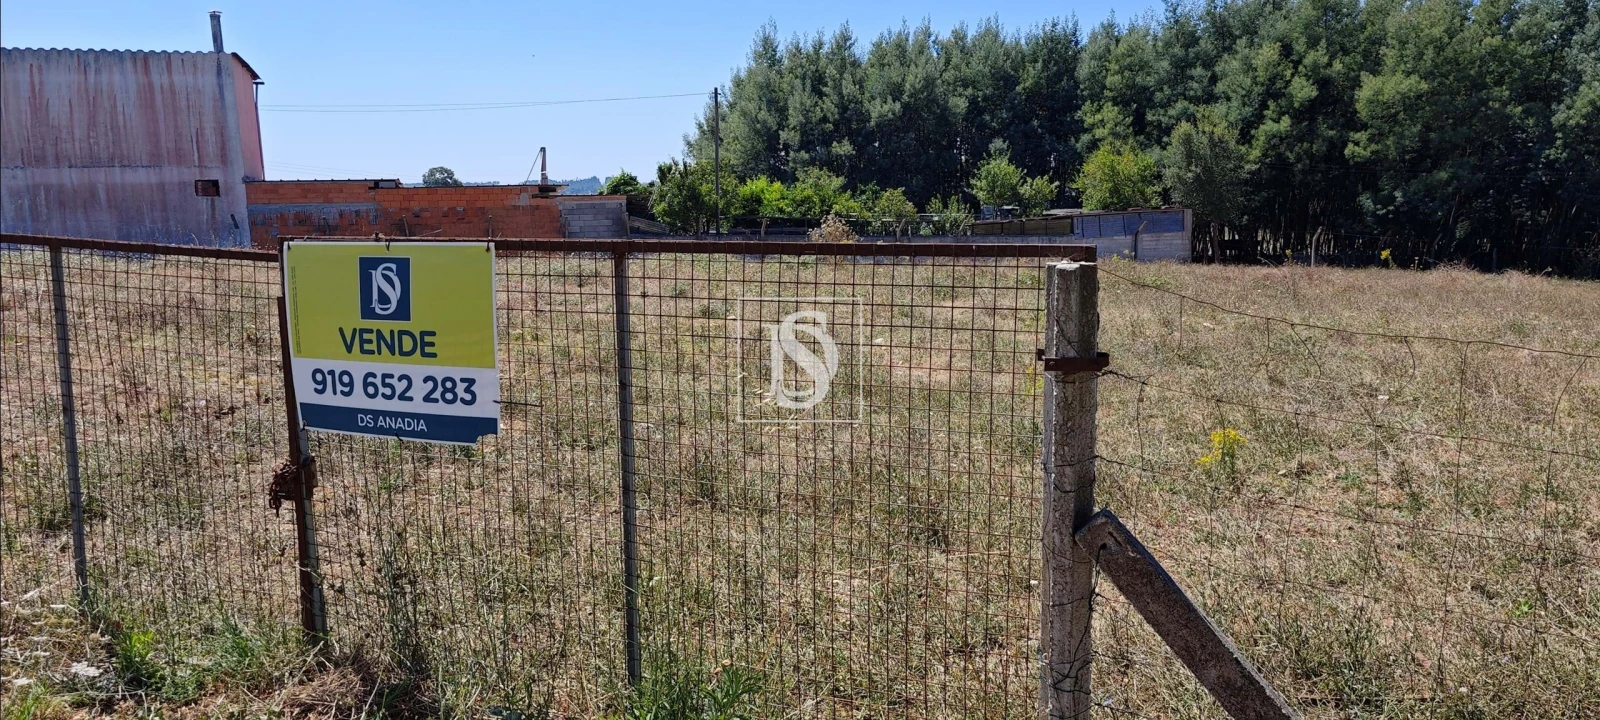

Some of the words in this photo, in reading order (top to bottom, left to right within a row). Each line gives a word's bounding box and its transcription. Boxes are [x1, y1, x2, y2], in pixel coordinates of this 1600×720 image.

[338, 326, 438, 359] VENDE
[311, 368, 355, 398] 919
[362, 371, 414, 402] 652
[422, 375, 477, 406] 283
[357, 413, 374, 428] DS
[377, 414, 428, 433] ANADIA
